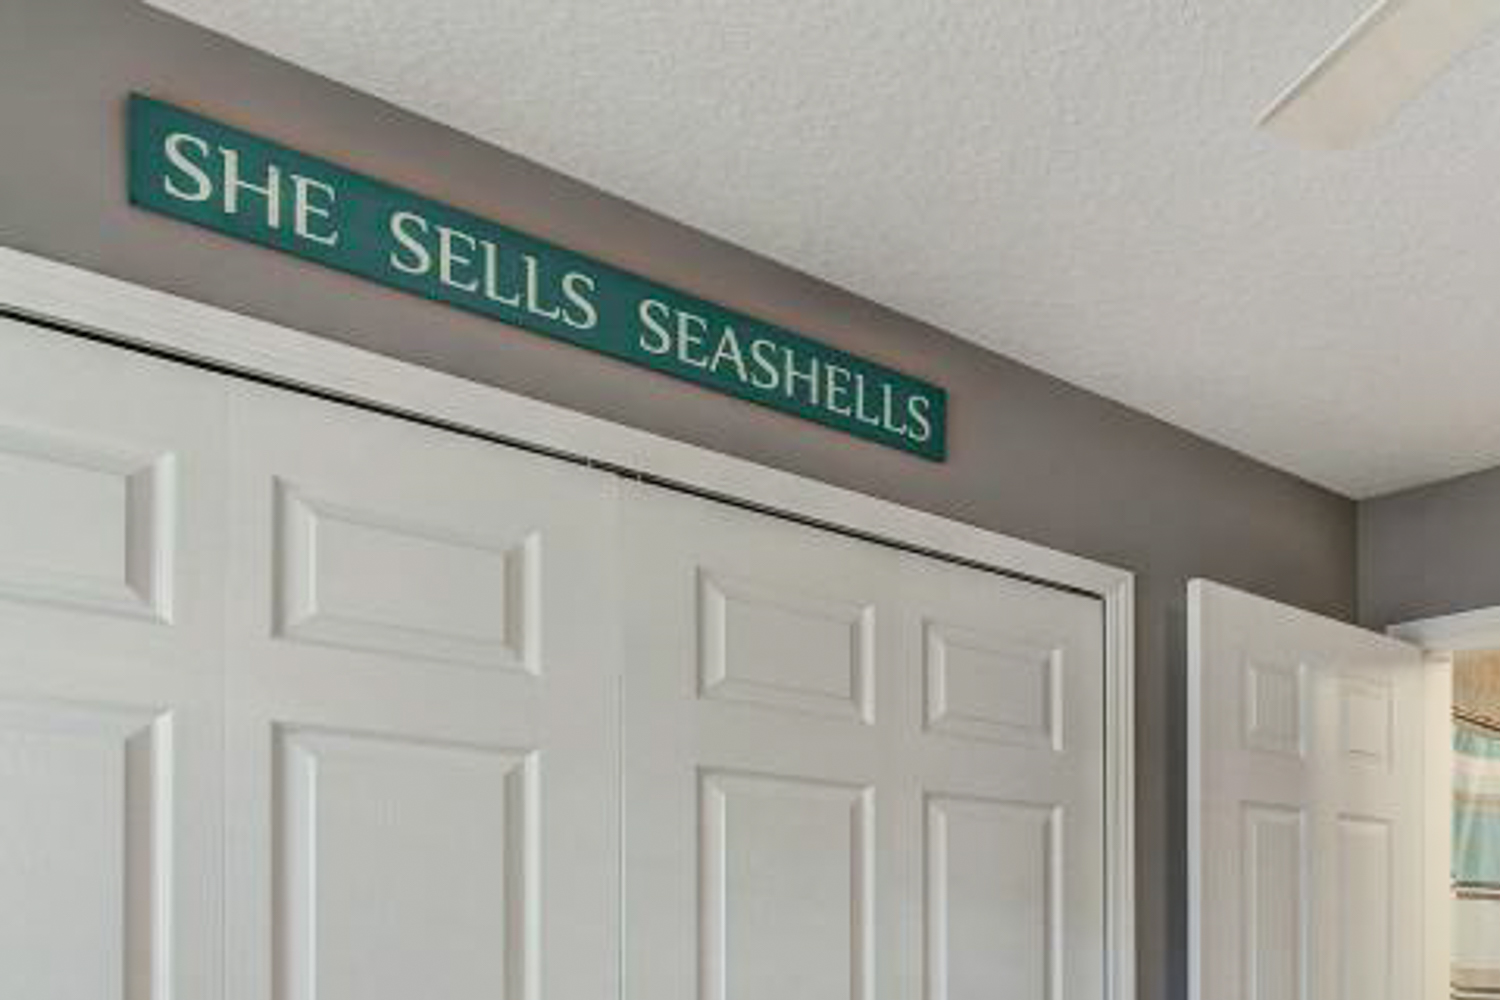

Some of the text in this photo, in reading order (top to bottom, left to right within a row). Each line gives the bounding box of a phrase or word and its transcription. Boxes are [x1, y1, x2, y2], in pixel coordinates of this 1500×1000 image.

[163, 132, 931, 442] SHE SELLS SEASHELLS
